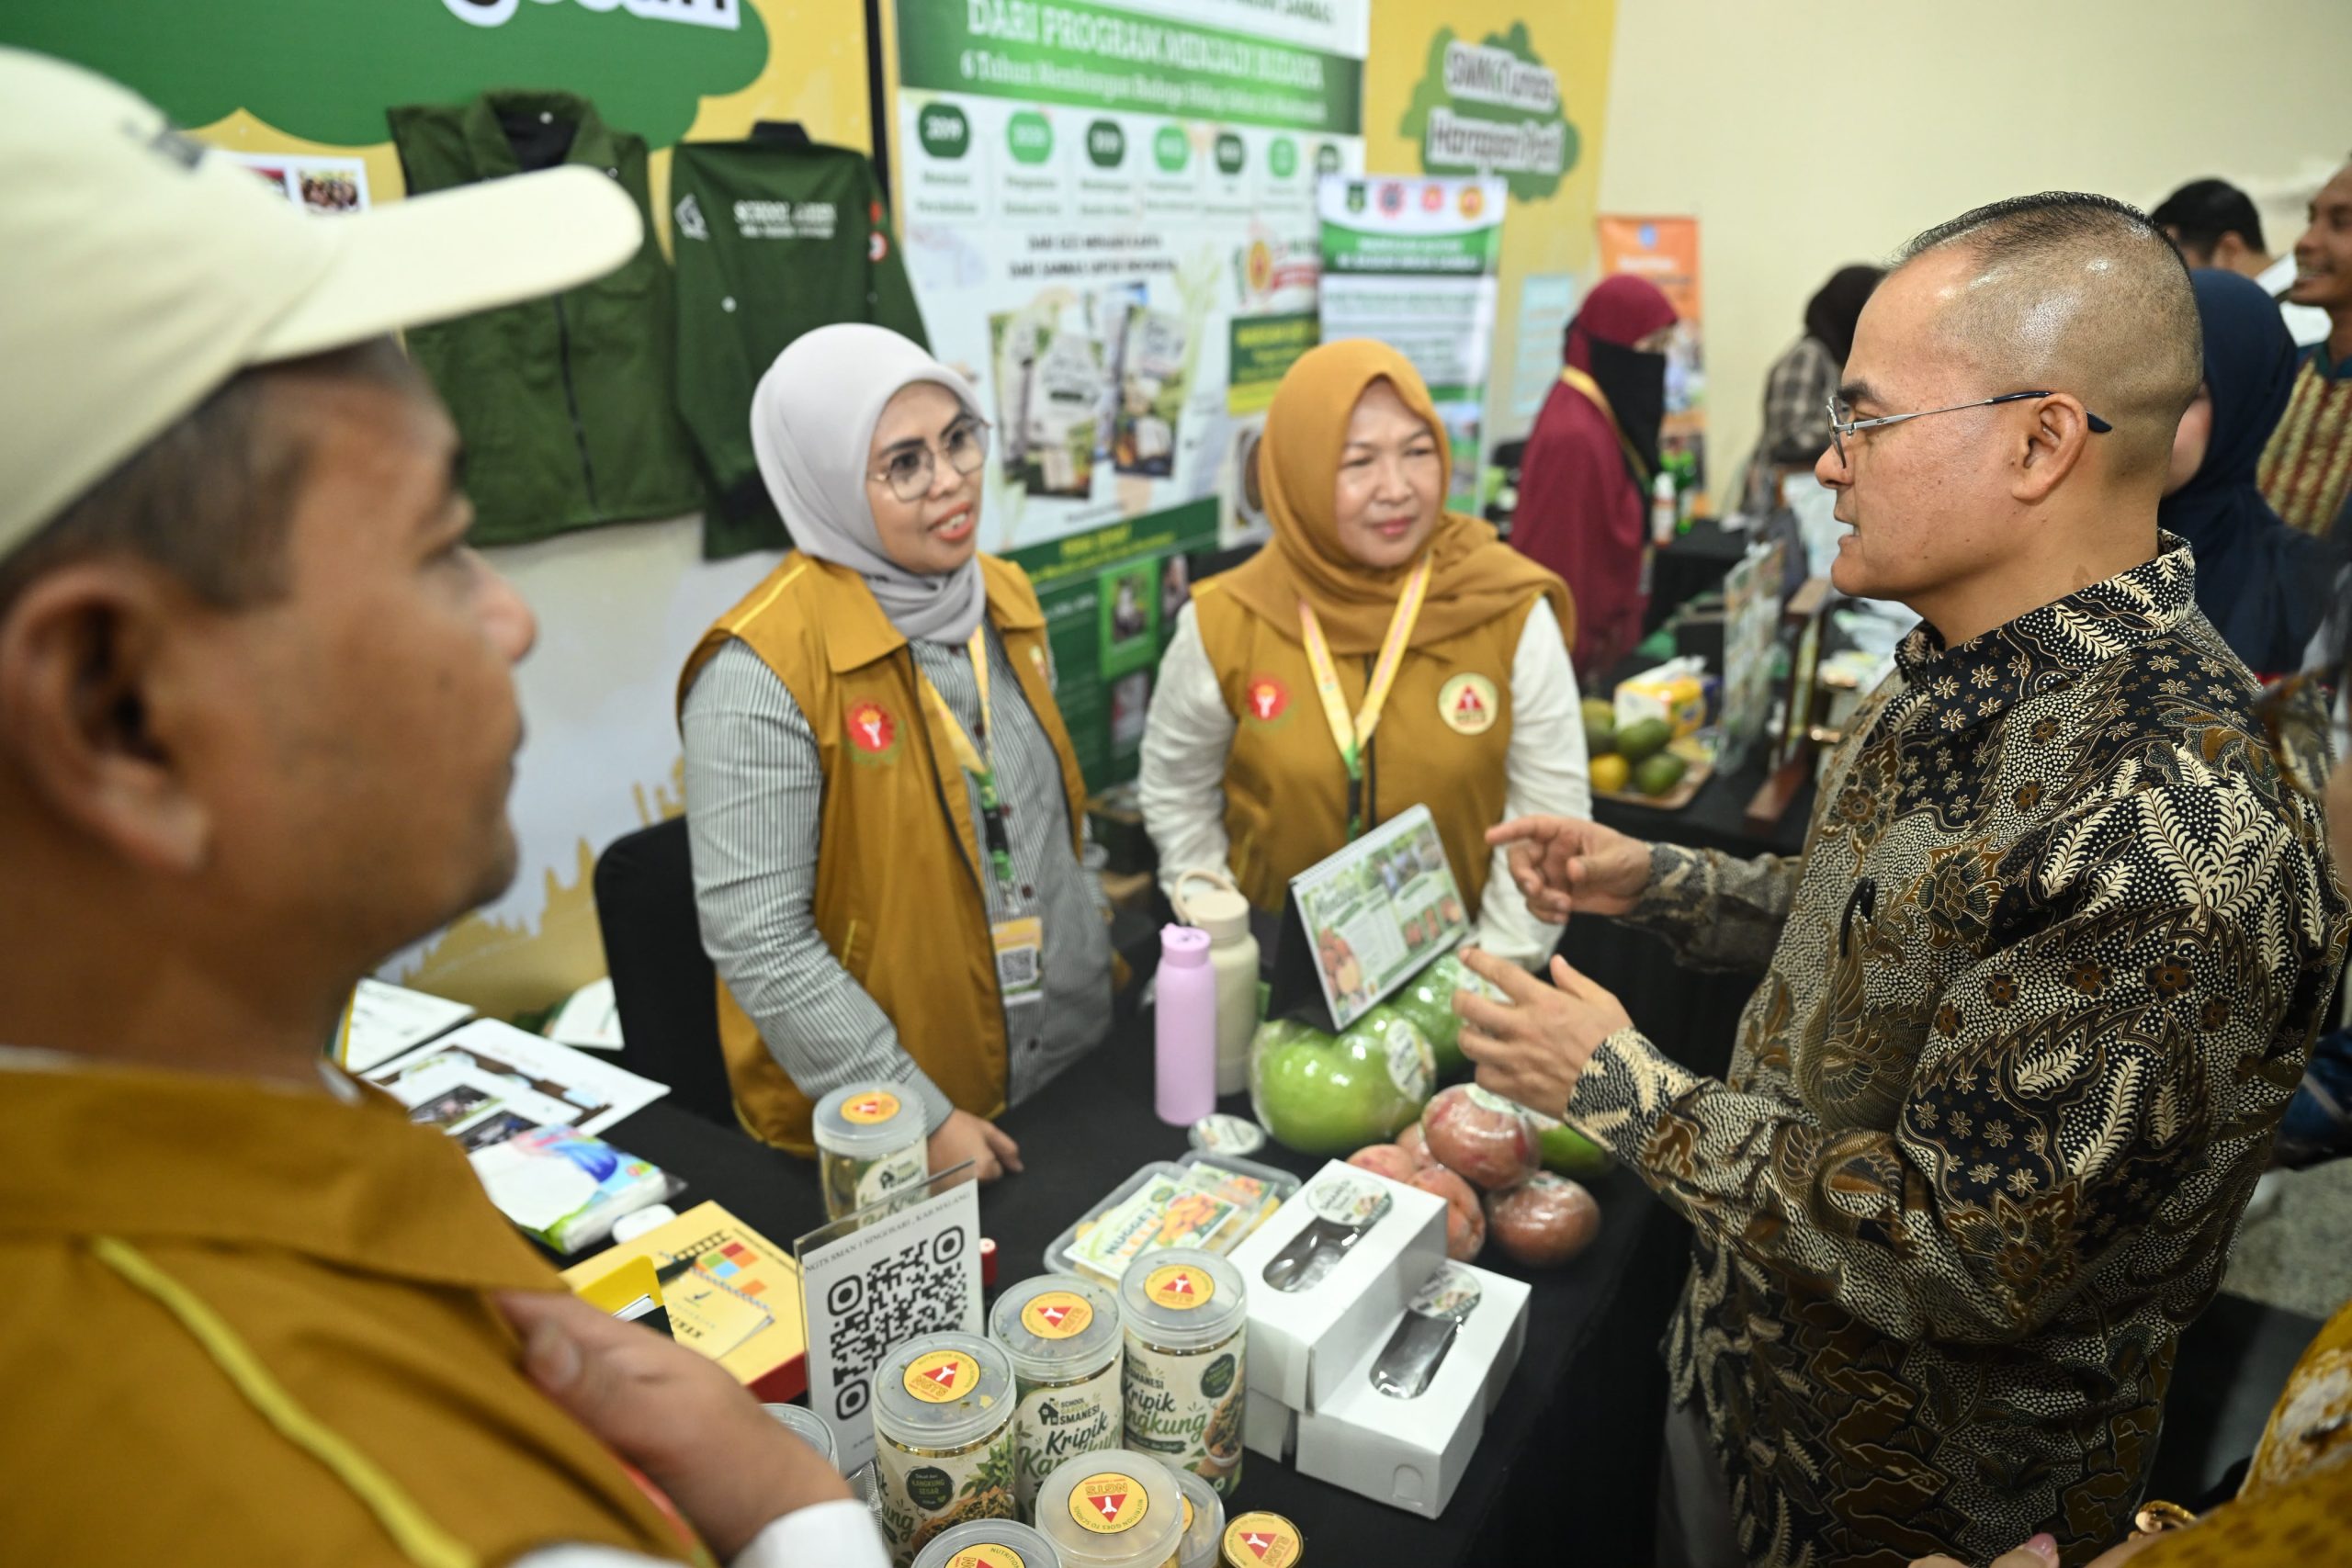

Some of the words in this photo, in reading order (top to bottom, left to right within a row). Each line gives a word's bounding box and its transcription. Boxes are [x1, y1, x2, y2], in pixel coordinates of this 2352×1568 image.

[967, 0, 1037, 43] DARI
[1042, 6, 1163, 64] PROGRAM
[960, 50, 977, 79] 6
[978, 51, 1032, 85] Tahun
[831, 1244, 856, 1261] SMAN
[1060, 1397, 1084, 1408] SCHOOL
[1059, 1404, 1101, 1426] SMANESI
[1046, 1412, 1108, 1456] Kripik
[1085, 1483, 1128, 1495] NGTS
[1123, 1499, 1143, 1526] NUTRITION
